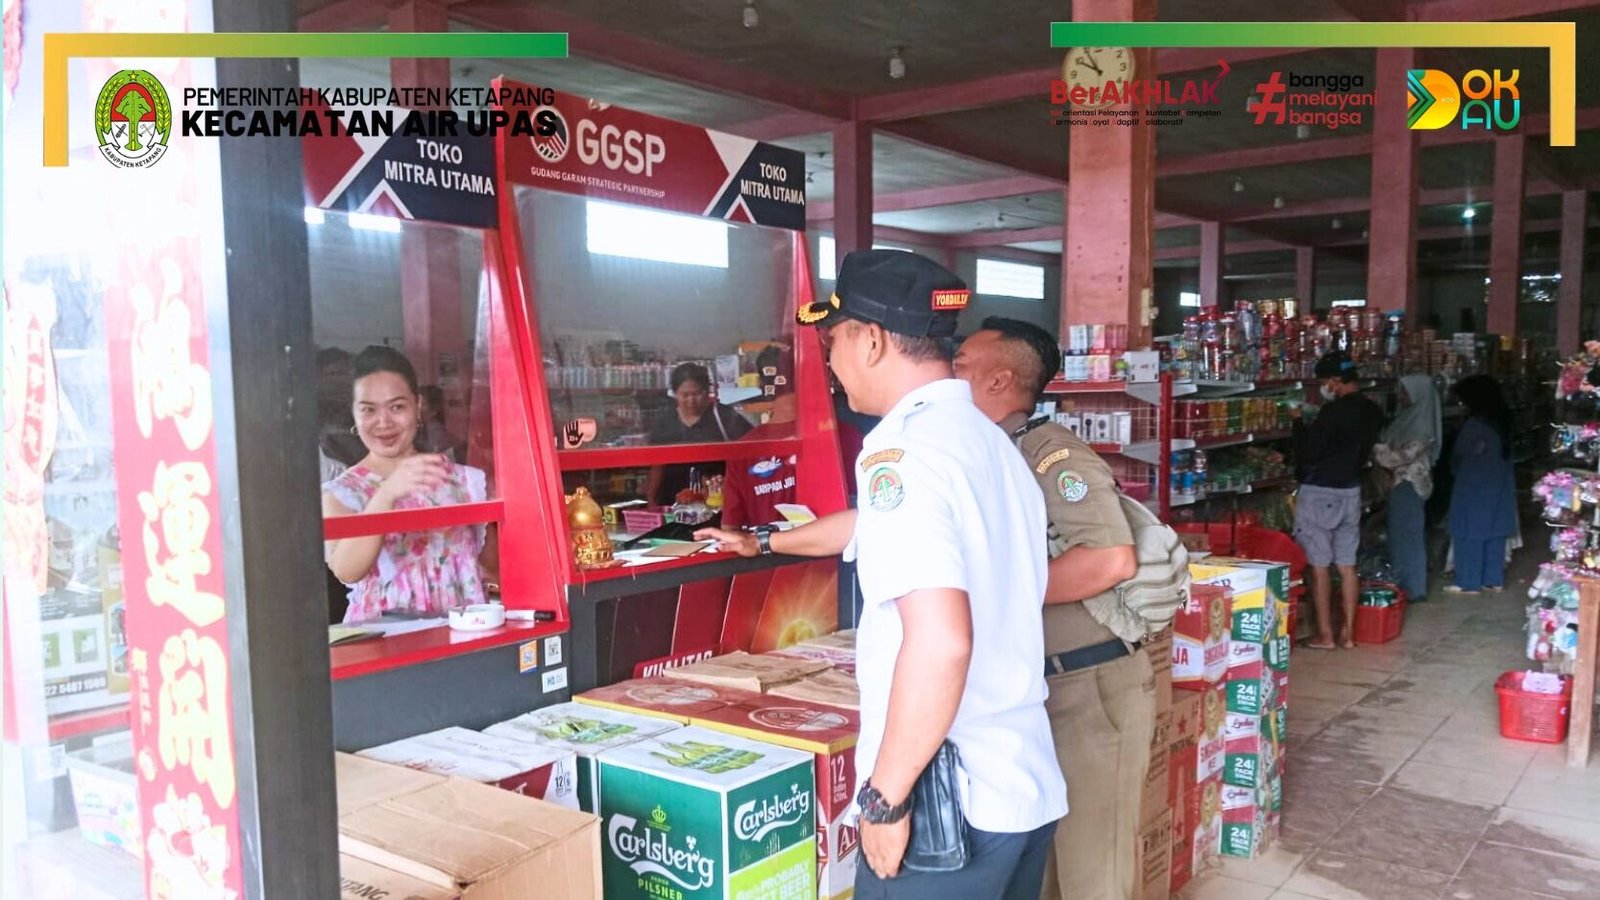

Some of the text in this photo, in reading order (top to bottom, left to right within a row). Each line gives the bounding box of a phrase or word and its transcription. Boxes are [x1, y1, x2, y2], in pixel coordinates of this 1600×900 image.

[416, 139, 463, 164] TOKO
[576, 119, 666, 177] GGSP
[384, 160, 495, 196] MITRA UTAMA
[530, 166, 561, 180] GUDANG
[562, 172, 586, 184] GARAM
[760, 162, 787, 182] TOKO
[741, 179, 805, 206] MITRA UTAMA
[1241, 612, 1257, 624] 24
[1236, 683, 1254, 695] 24
[831, 755, 846, 784] 12
[1234, 757, 1251, 768] 24
[734, 789, 810, 841] Carlsberg
[608, 813, 715, 890] Carlsberg
[638, 879, 684, 900] PILSNER
